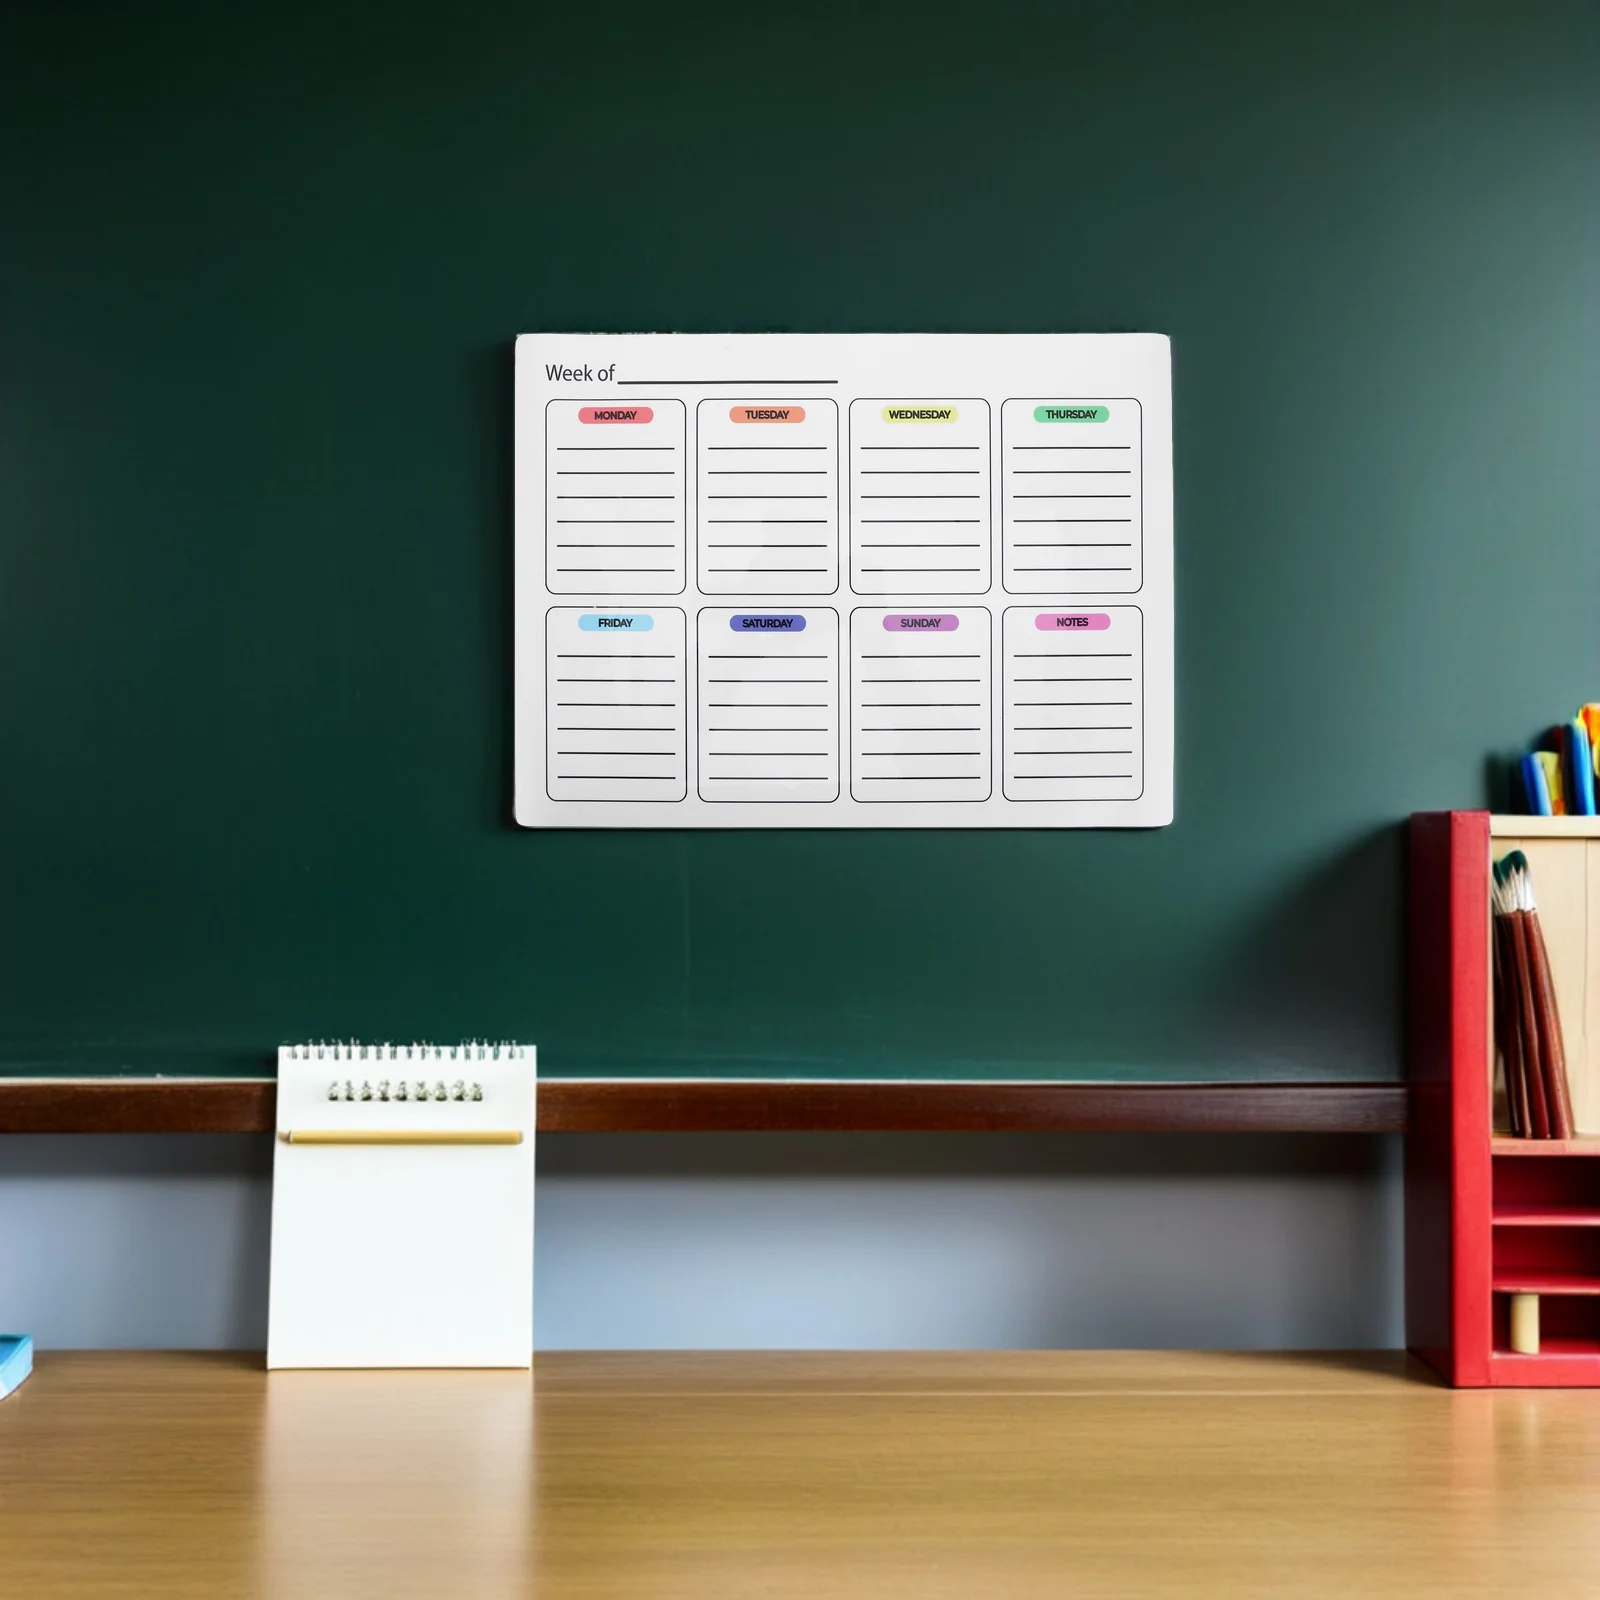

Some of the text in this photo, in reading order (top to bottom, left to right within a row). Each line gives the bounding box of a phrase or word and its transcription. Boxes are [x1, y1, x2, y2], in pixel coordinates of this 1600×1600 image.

[545, 363, 616, 382] Week of
[594, 410, 637, 421] MONDAY
[745, 410, 790, 420] TUESDAY
[888, 409, 952, 420] WEDNESDAY
[1045, 409, 1098, 420] THURSDAY
[598, 618, 634, 628] FRIDAY
[742, 618, 794, 629] SATURDAY
[900, 618, 942, 628] SUNDAY
[1056, 617, 1089, 628] NOTES
